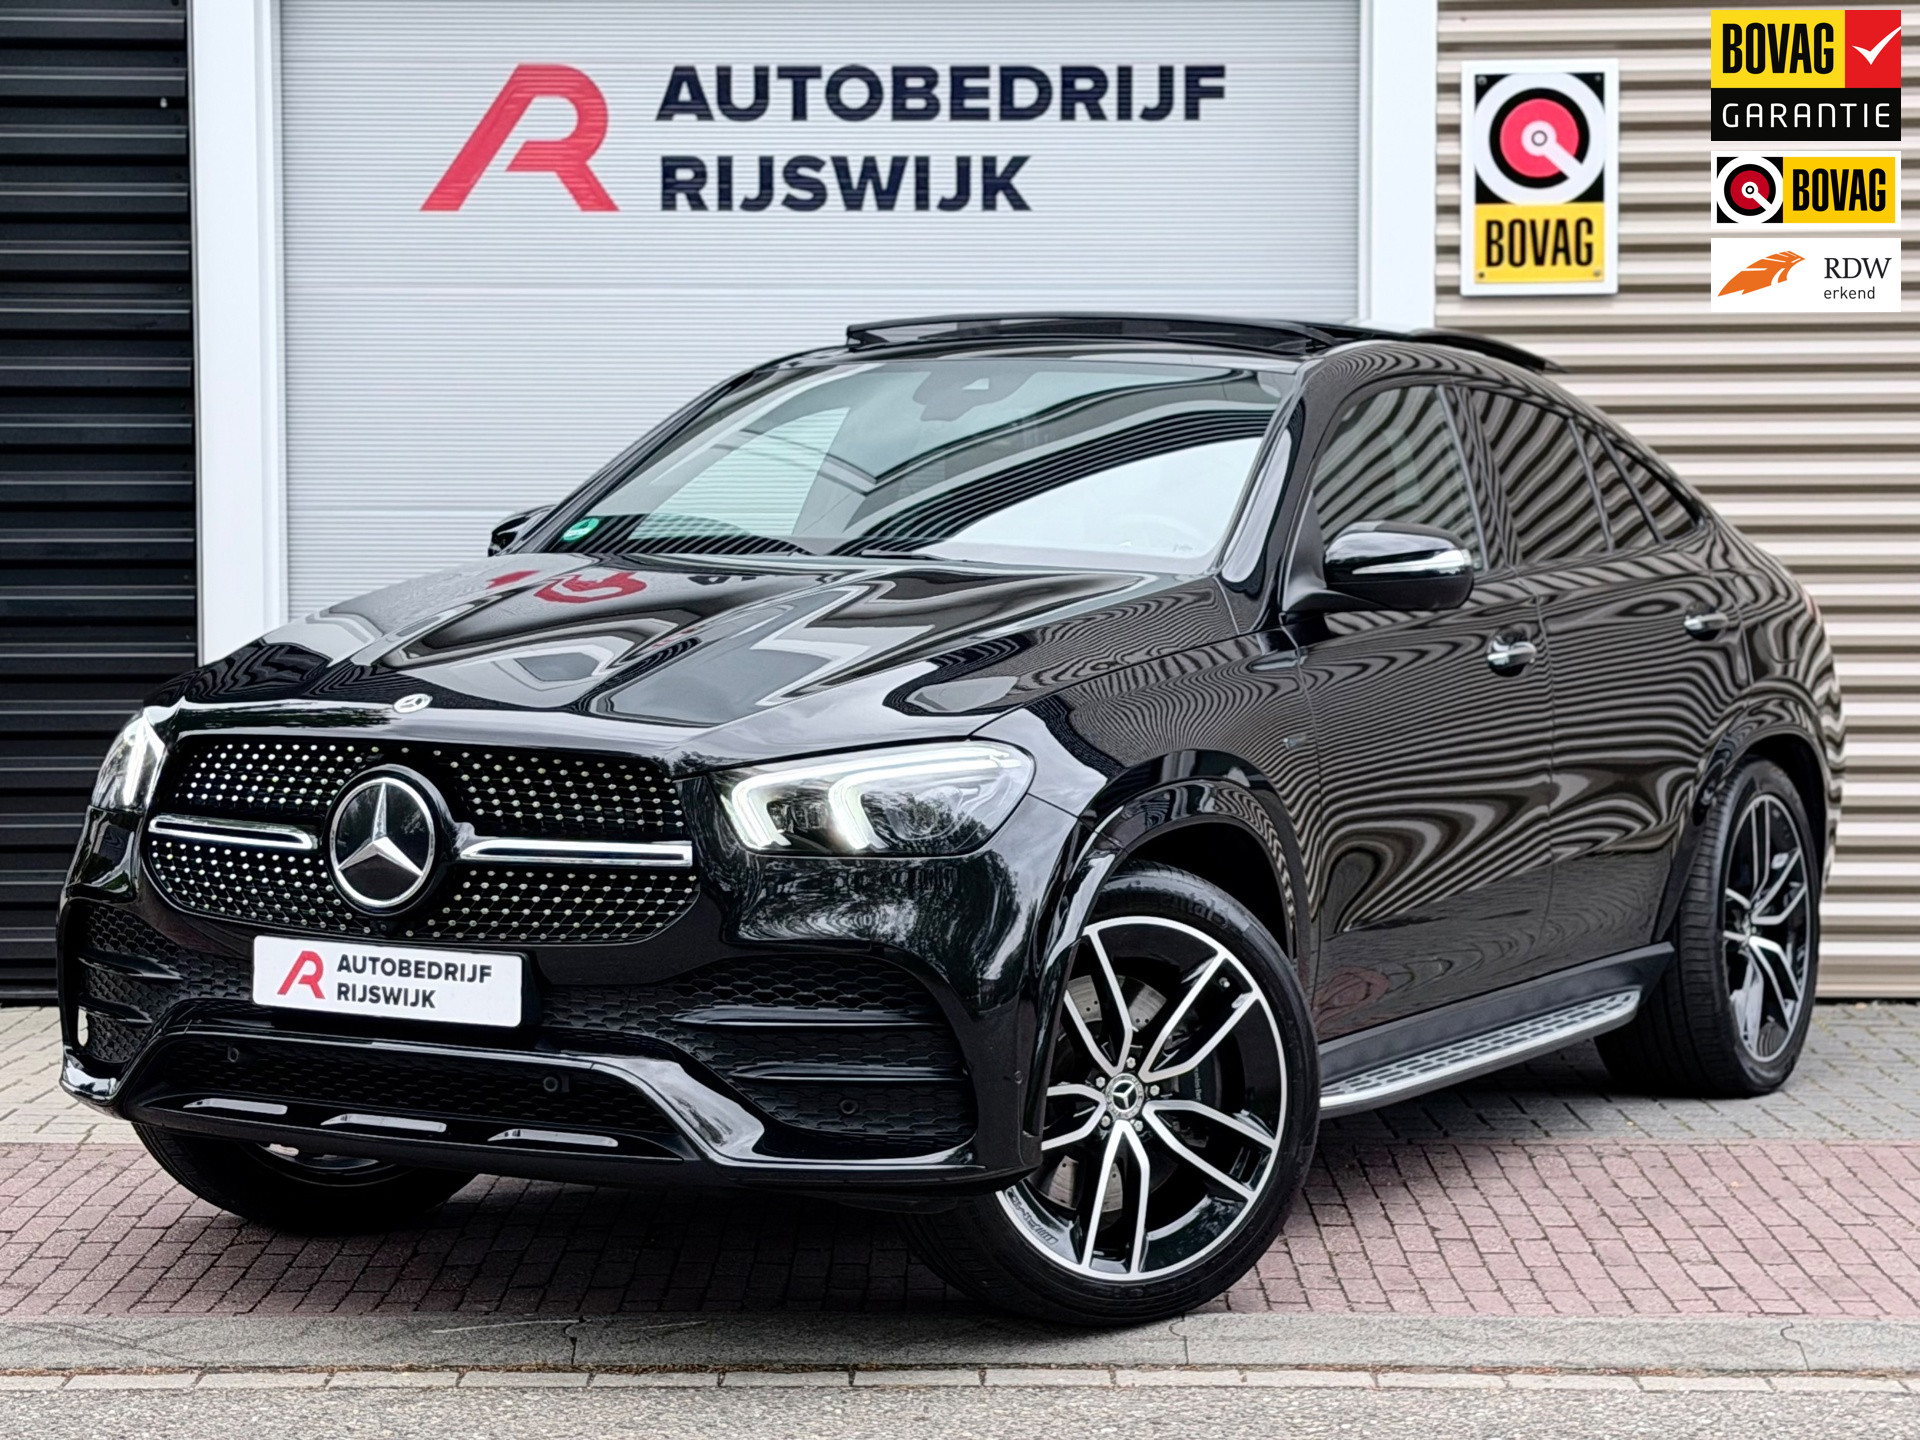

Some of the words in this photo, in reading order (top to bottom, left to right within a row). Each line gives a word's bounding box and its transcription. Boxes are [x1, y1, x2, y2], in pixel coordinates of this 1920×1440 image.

[655, 64, 1226, 122] AUTOBEDRIJF
[660, 155, 1032, 212] RIJSWIJK
[1485, 217, 1594, 268] BOVAG
[337, 954, 492, 983] AUTOBEDRIJF
[337, 982, 436, 1009] RIJSWIJK
